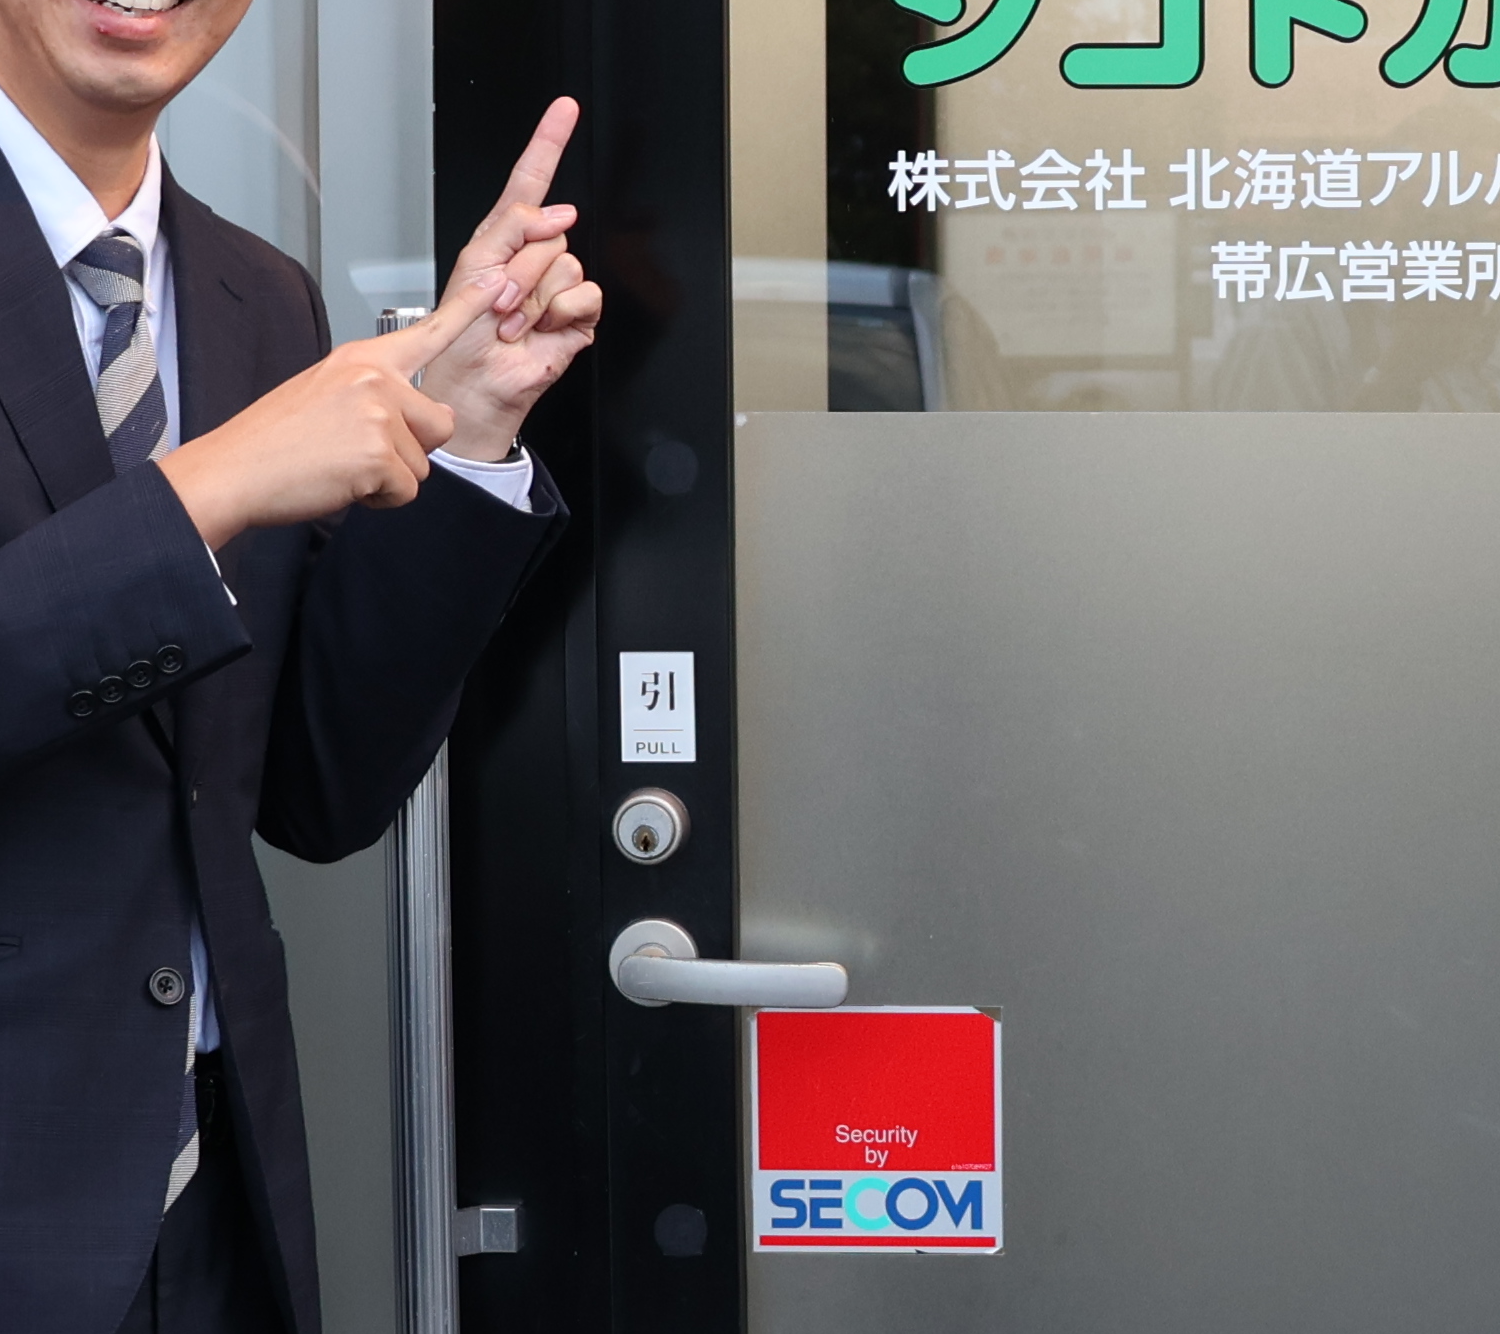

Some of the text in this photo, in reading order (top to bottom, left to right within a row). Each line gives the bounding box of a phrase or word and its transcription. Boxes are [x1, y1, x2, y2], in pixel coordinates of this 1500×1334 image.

[887, 148, 1148, 212] 株式会社
[640, 671, 676, 711] 引
[635, 741, 682, 755] PULL
[835, 1124, 918, 1148] Security
[864, 1146, 889, 1168] by
[770, 1177, 983, 1230] SECOM
